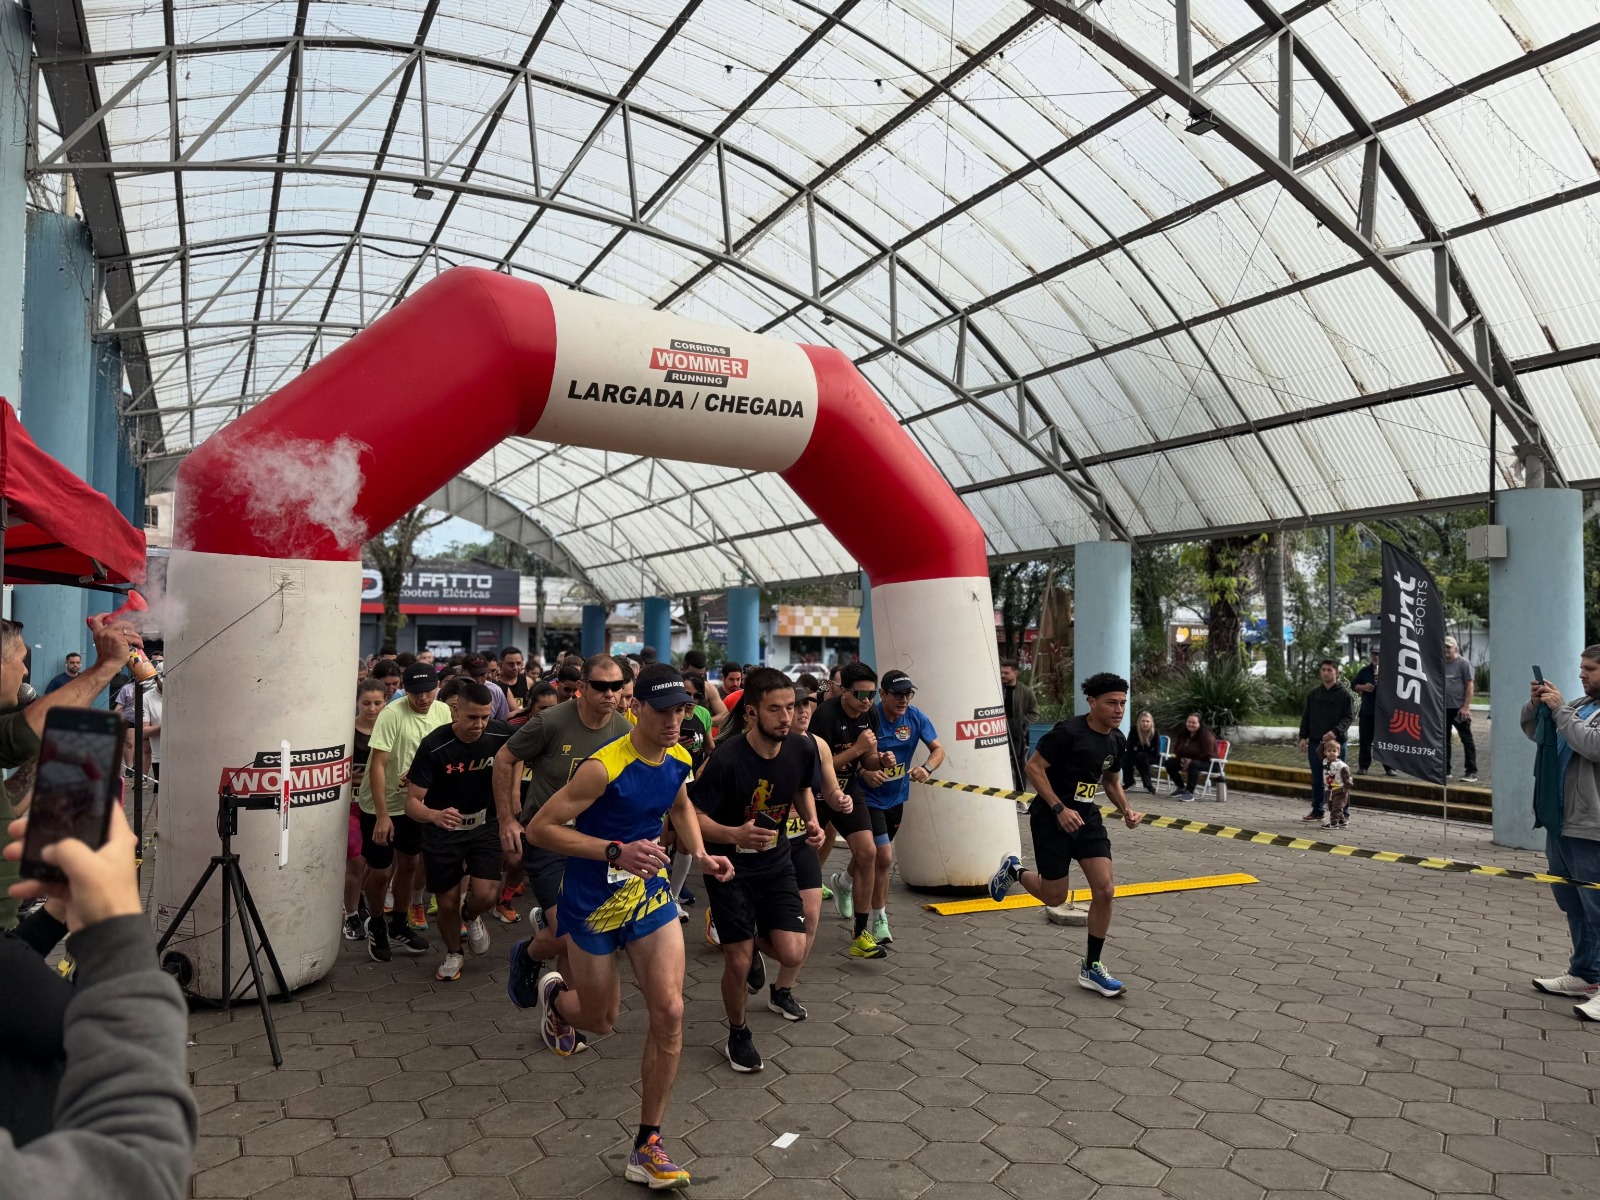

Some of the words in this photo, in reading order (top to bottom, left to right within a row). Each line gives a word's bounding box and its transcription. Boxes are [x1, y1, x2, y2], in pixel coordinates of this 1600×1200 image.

[674, 341, 726, 355] CORRIDAS
[656, 352, 744, 375] WOMMER
[671, 373, 723, 385] RUNNING
[567, 380, 685, 410] LARGADA
[704, 394, 805, 418] CHEGADA
[418, 573, 493, 588] FATTO
[400, 588, 439, 598] cooters
[442, 588, 491, 599] Elétricas
[1416, 580, 1428, 636] SPORTS
[1388, 571, 1428, 705] sprint
[229, 761, 351, 791] WOMMER
[1076, 783, 1096, 798] 20
